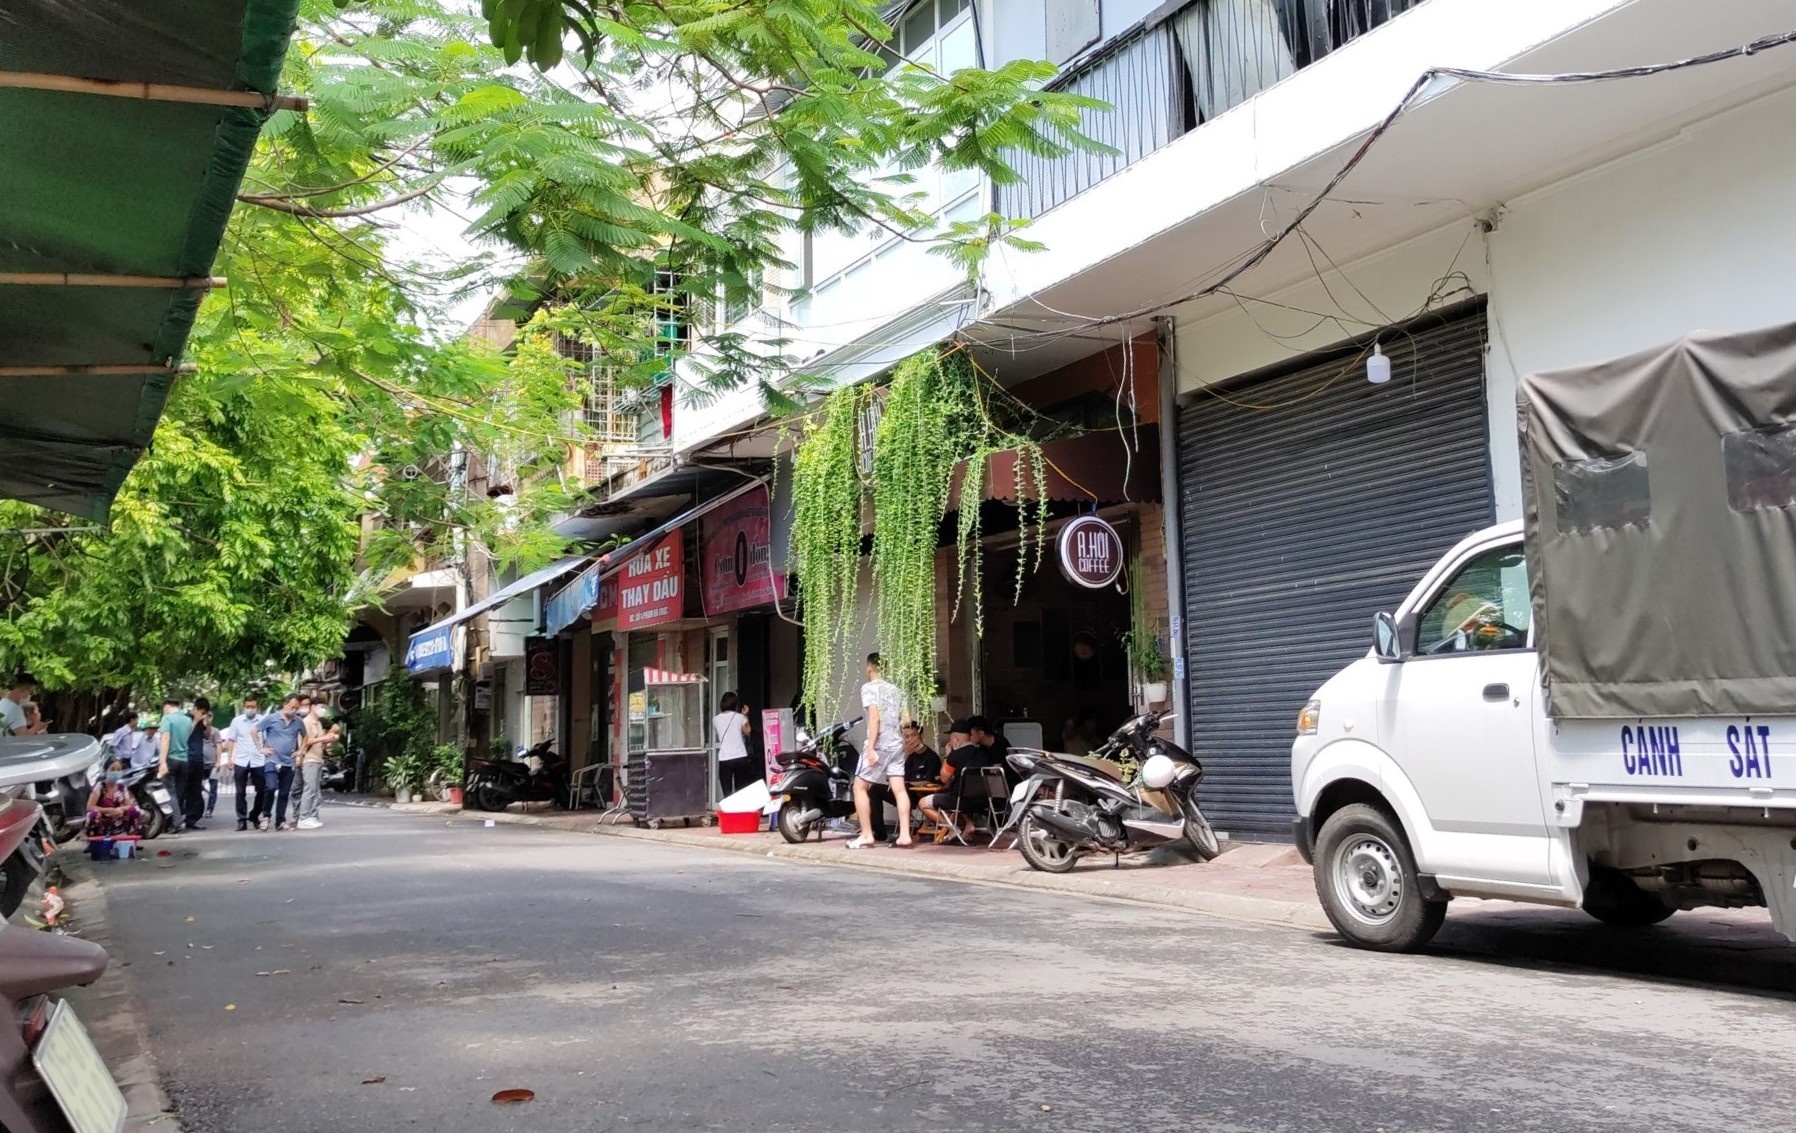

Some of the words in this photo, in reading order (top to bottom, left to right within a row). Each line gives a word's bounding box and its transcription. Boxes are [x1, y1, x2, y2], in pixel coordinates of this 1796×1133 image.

[655, 546, 671, 570] XE
[1078, 558, 1110, 574] COFFEE
[621, 583, 650, 609] THAY
